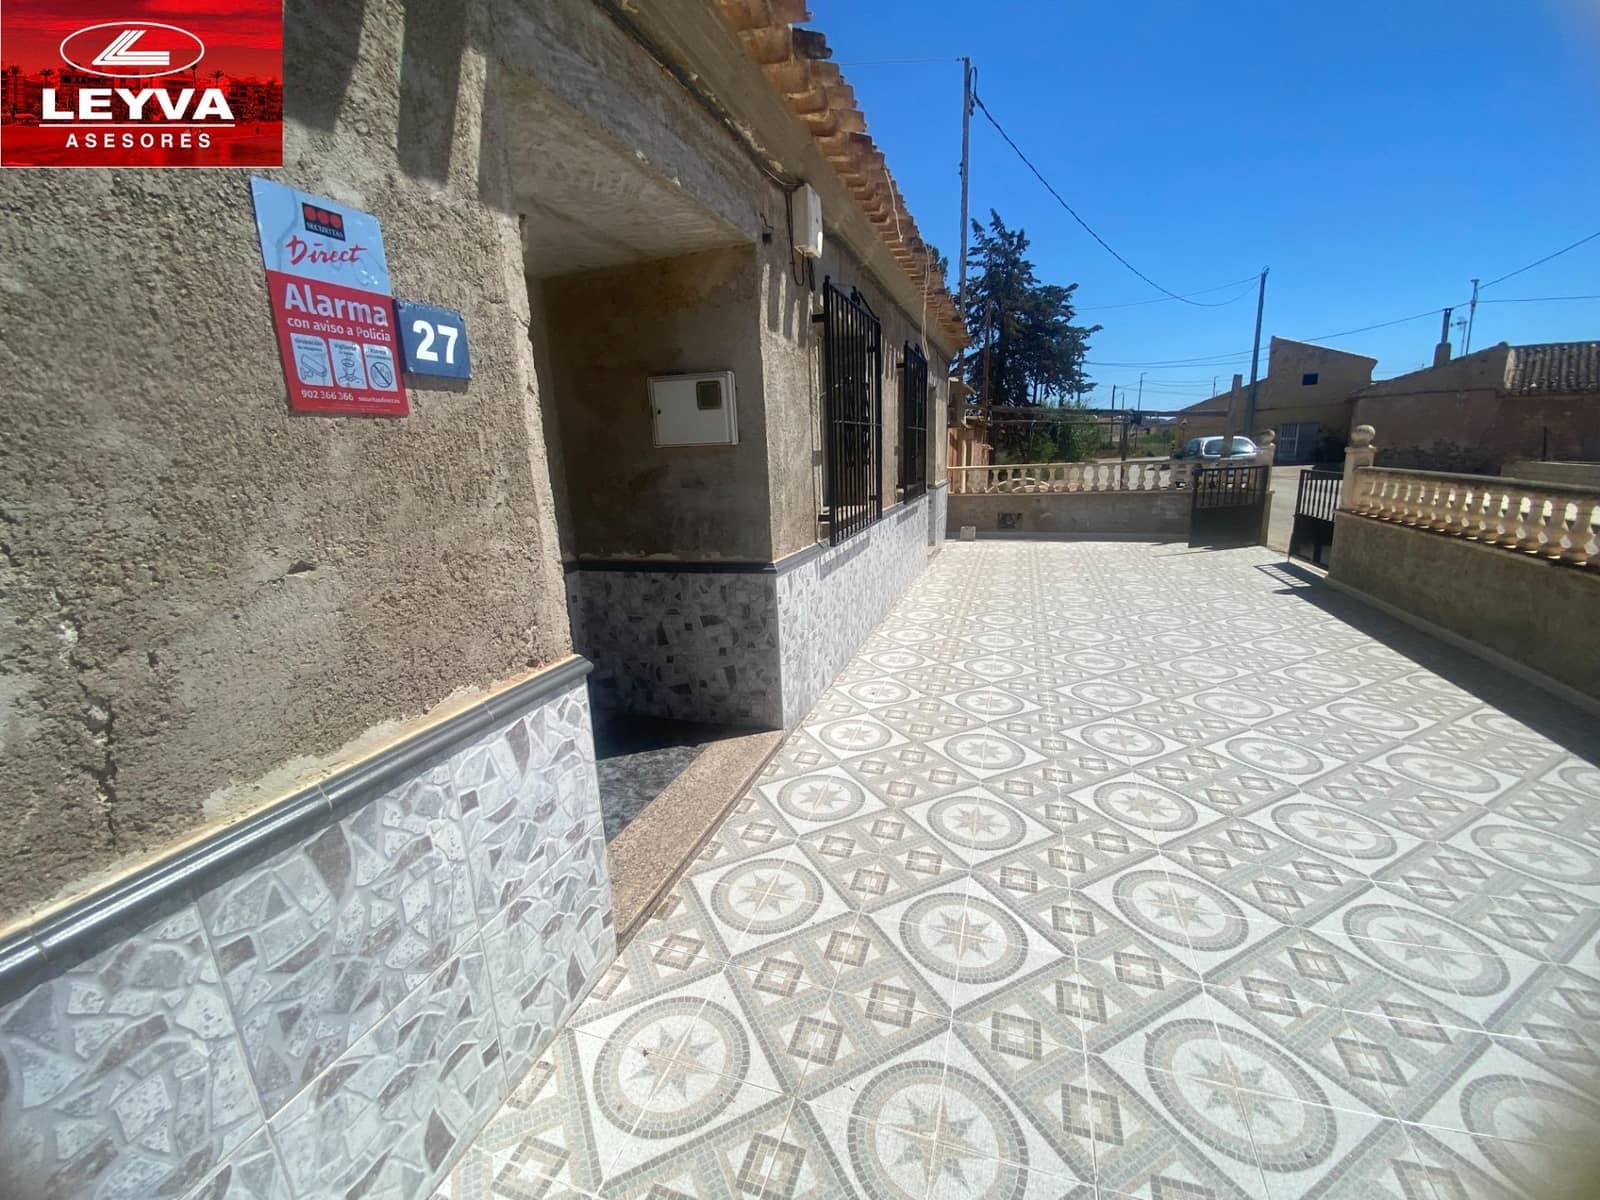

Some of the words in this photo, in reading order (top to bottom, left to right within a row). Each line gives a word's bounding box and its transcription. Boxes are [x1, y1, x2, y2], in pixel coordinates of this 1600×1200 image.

[286, 235, 368, 266] Direct
[284, 283, 389, 327] Alarma
[287, 317, 311, 330] con
[313, 320, 345, 336] aviso
[346, 325, 354, 337] a
[412, 320, 459, 365] 27
[301, 389, 319, 399] 902
